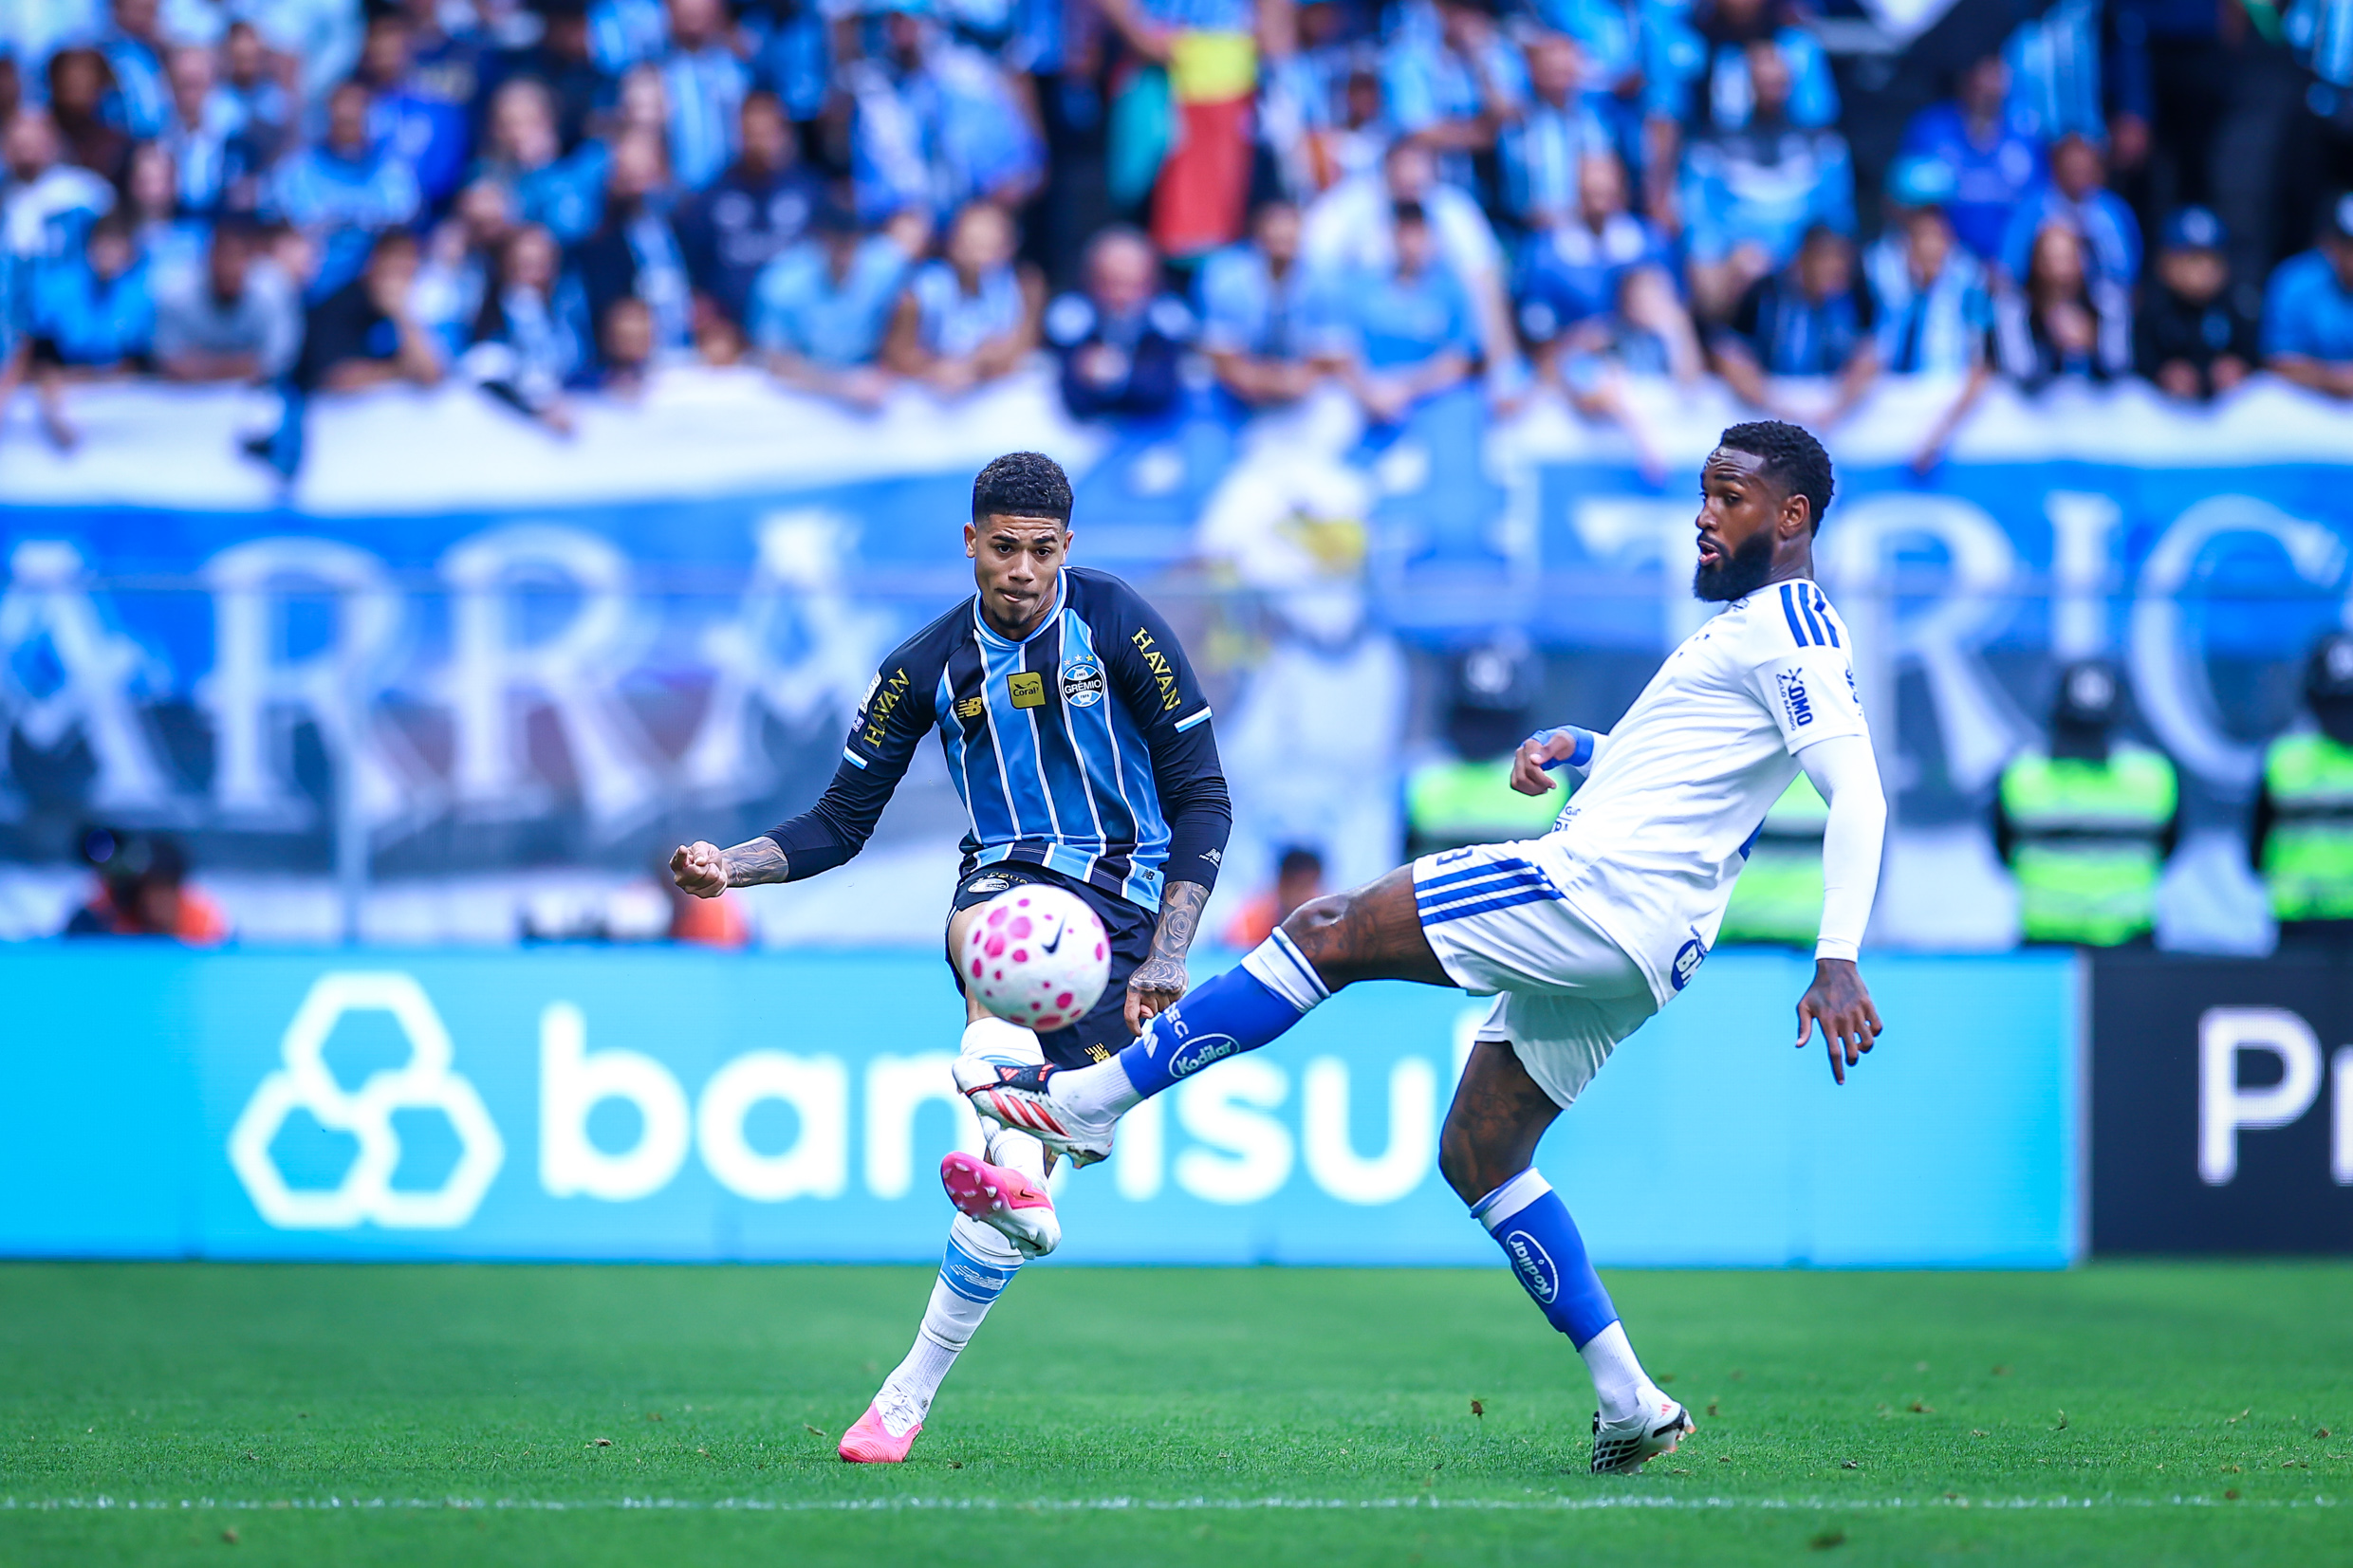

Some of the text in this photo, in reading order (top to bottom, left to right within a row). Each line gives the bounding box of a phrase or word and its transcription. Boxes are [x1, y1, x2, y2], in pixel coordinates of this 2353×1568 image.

[1012, 687, 1036, 697] Coral
[1065, 679, 1102, 694] GRÊMIO
[1131, 627, 1181, 710] HAVAN
[863, 667, 910, 747] HAVAN
[1788, 686, 1813, 727] OMO
[1176, 1041, 1232, 1075] Kodilar
[538, 999, 1488, 1205] banisu
[1510, 1241, 1552, 1296] Kodilar
